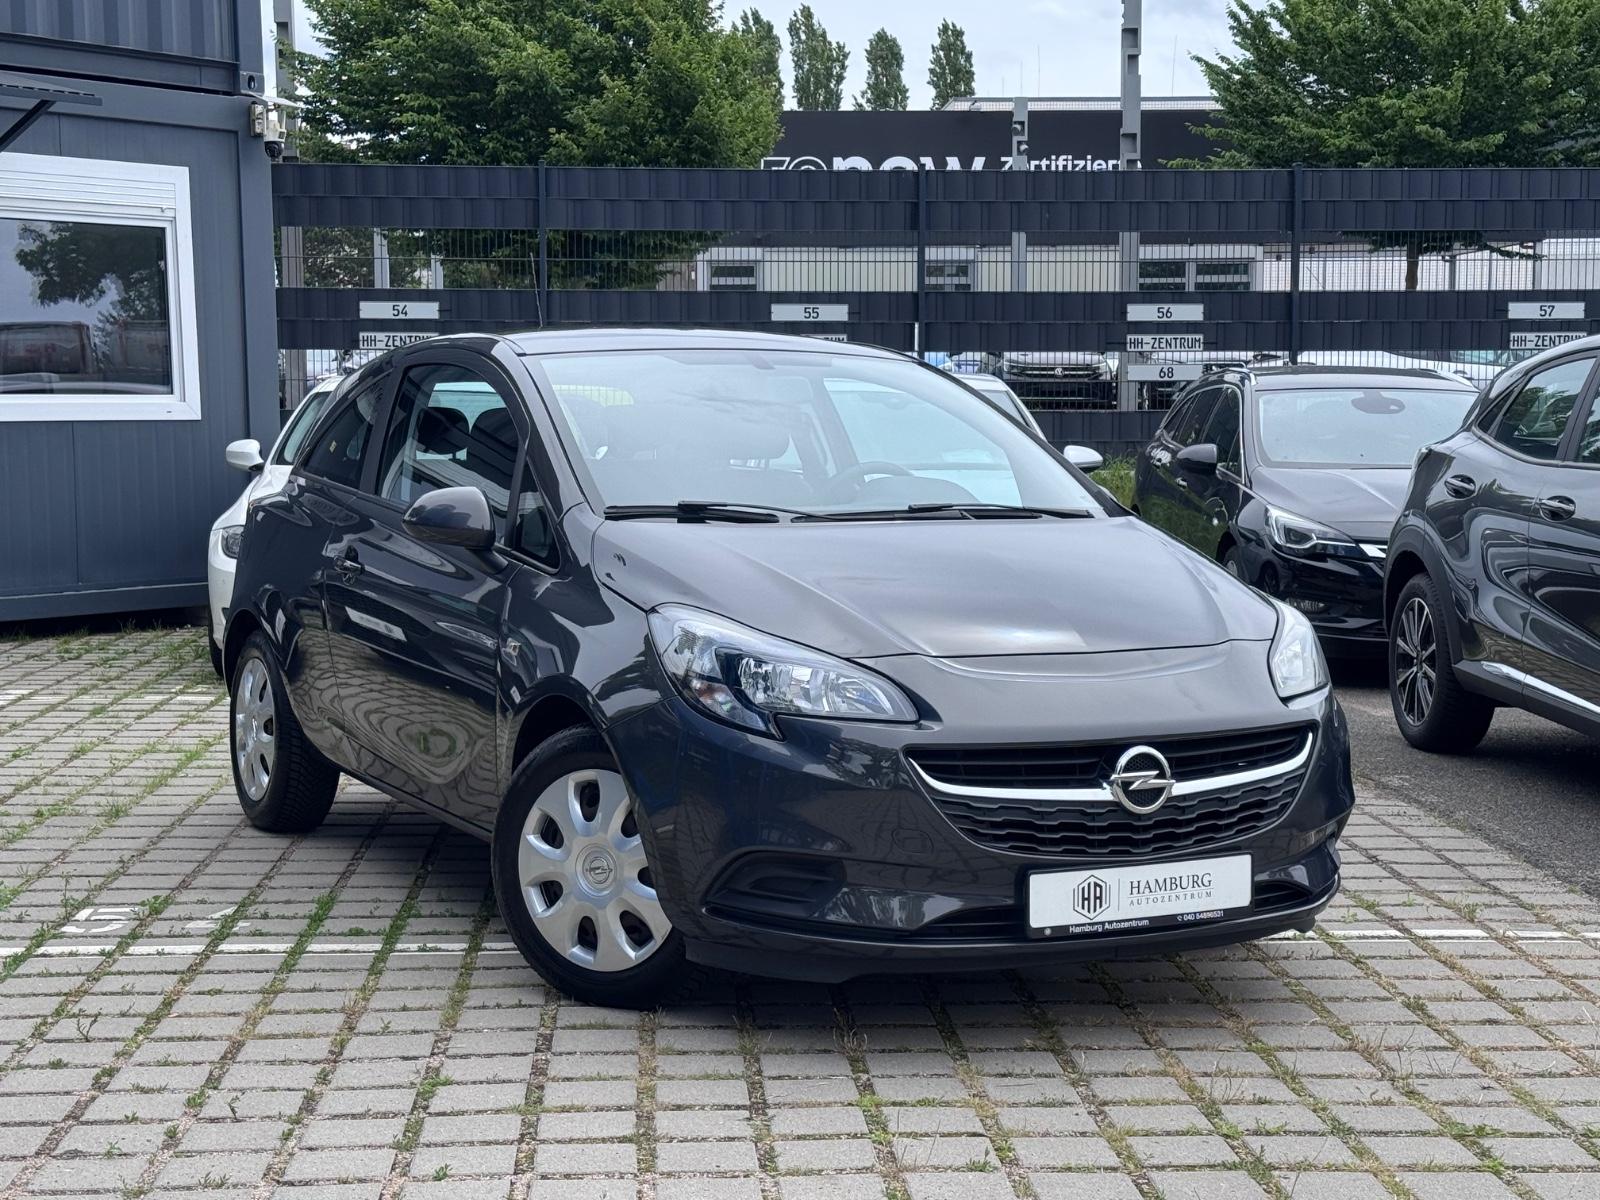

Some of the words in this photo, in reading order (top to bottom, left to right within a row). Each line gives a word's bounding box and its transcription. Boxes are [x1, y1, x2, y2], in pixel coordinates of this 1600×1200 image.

[392, 304, 408, 317] 54
[804, 307, 820, 319] 55
[1157, 307, 1173, 319] 56
[1539, 305, 1555, 317] 57
[1129, 337, 1201, 350] HH-ZENTRUM
[1159, 367, 1174, 379] 68
[1129, 872, 1212, 896] HAMBURG
[1129, 891, 1212, 907] AUTOZENTRUM
[1183, 913, 1195, 921] 040
[1069, 924, 1103, 934] Hamburg
[1104, 919, 1149, 930] Autozentrum
